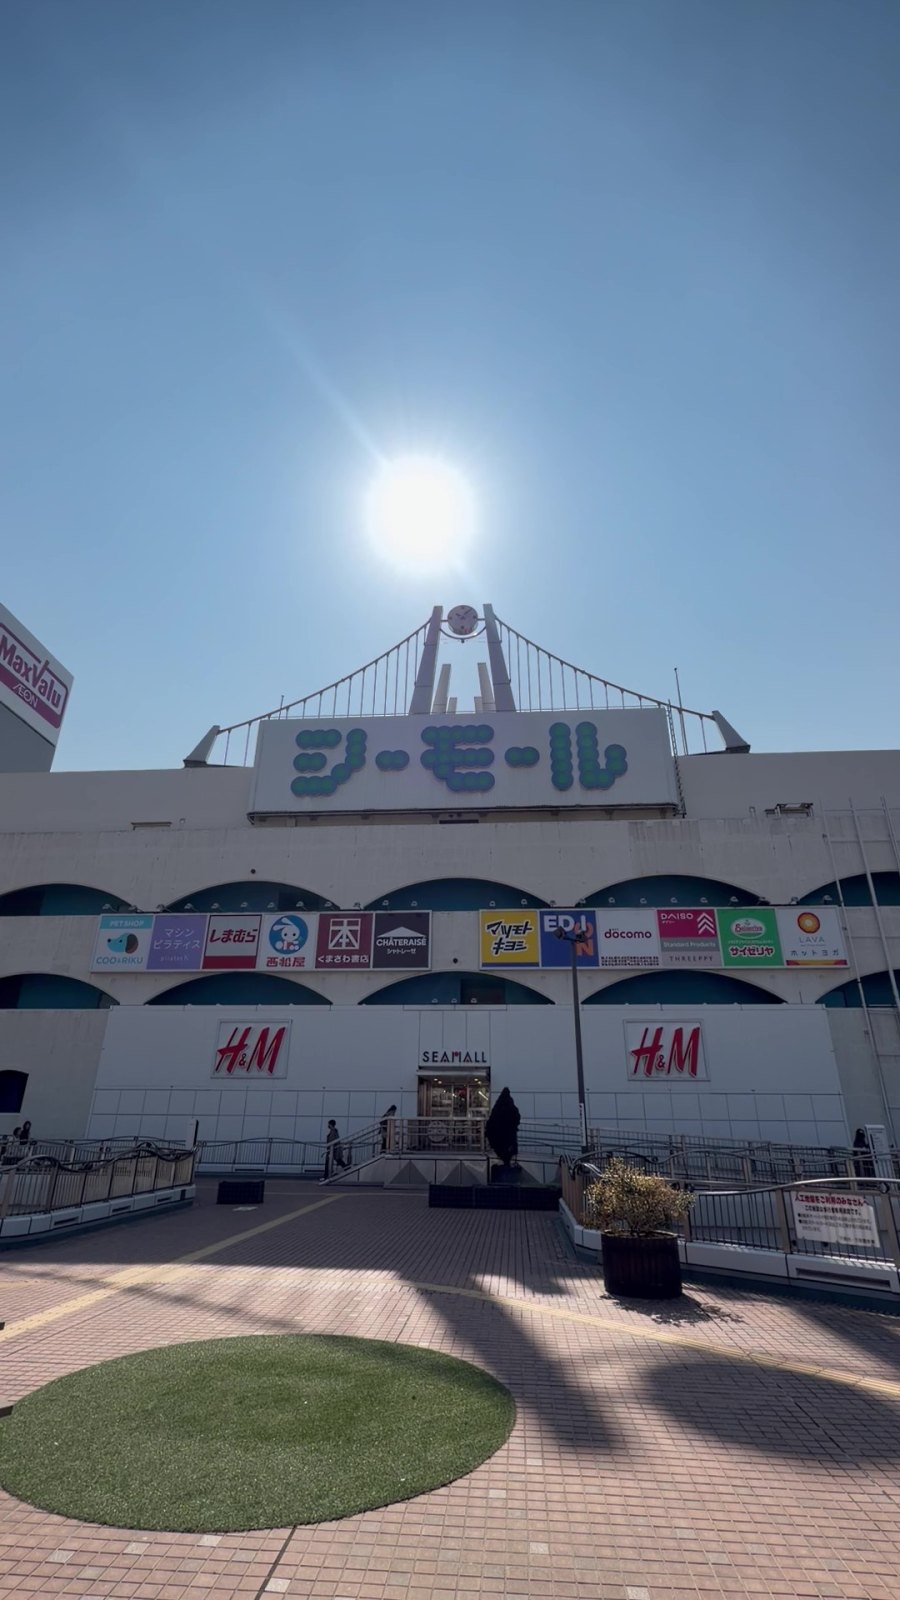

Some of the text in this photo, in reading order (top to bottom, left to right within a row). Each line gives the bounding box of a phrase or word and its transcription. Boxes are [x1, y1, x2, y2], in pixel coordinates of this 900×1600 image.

[0, 634, 62, 709] MaxValu
[290, 721, 628, 798] シーモール
[164, 928, 195, 938] マシン
[209, 928, 258, 943] しまむら
[486, 920, 533, 938] マツモト
[604, 928, 652, 939] docomo
[153, 940, 201, 950] ピラティス
[492, 938, 527, 955] キヨシ
[730, 946, 773, 956] サイゼリヤ
[266, 956, 306, 968] 西松屋
[217, 1027, 286, 1074] H&M
[422, 1051, 487, 1063] SEAMALL
[631, 1026, 701, 1077] H&M
